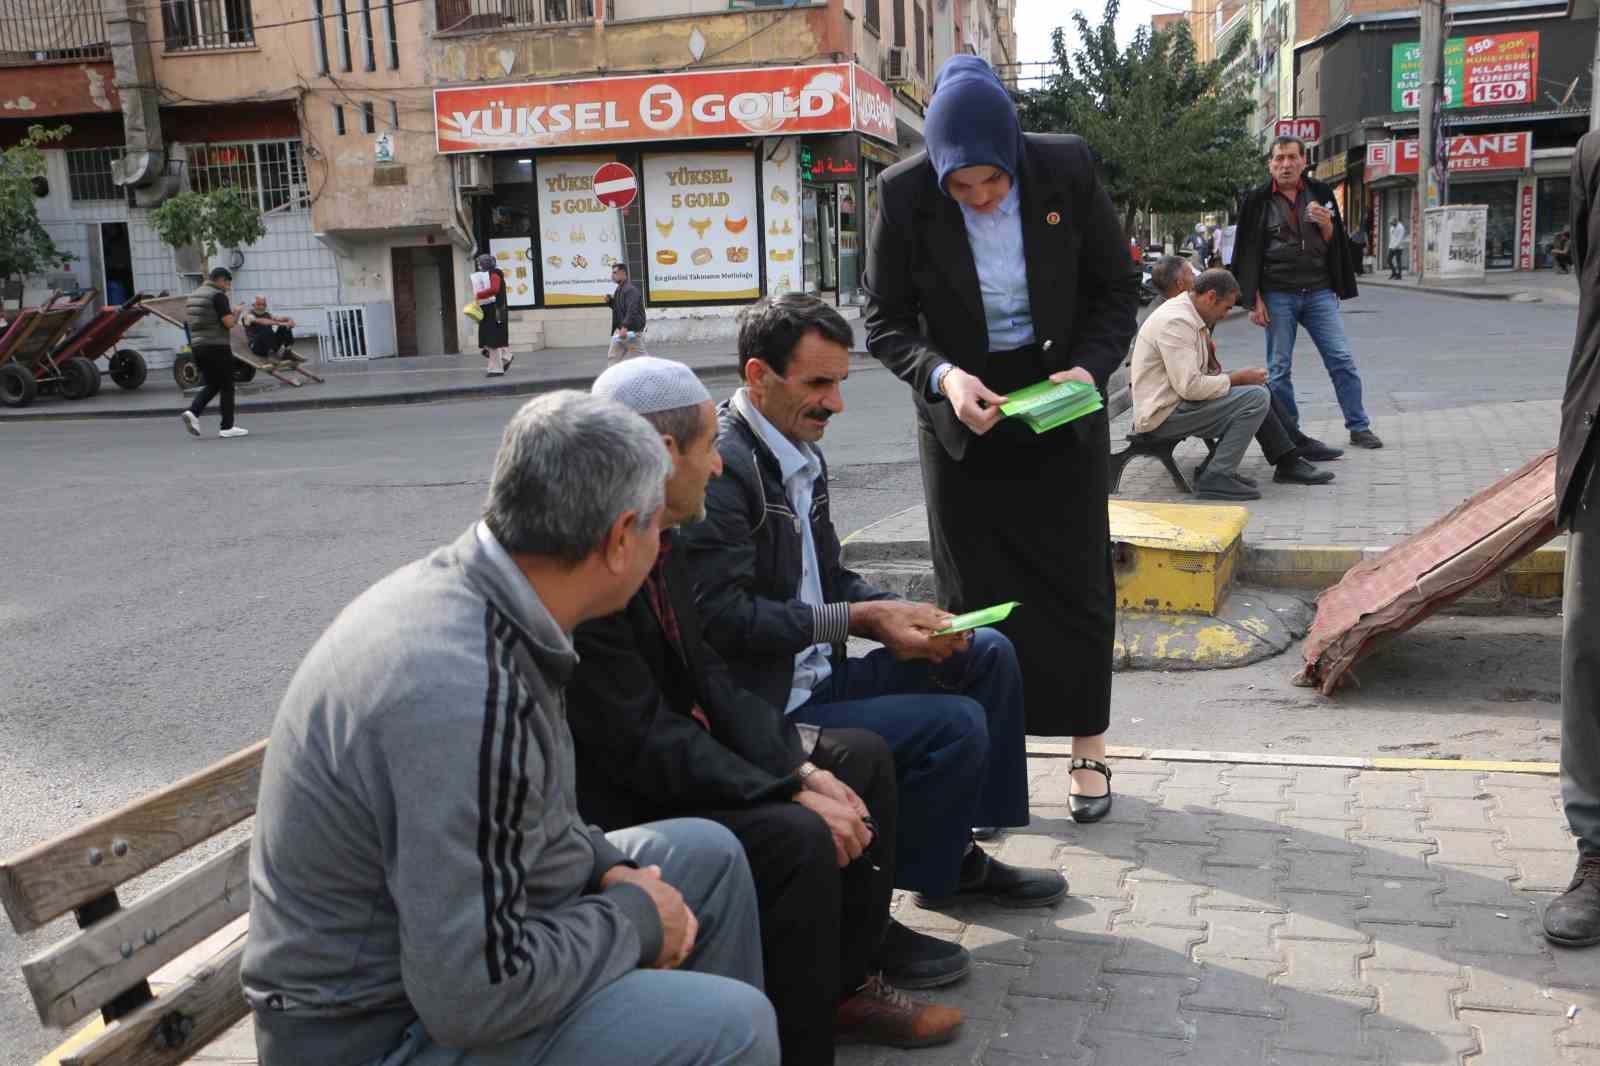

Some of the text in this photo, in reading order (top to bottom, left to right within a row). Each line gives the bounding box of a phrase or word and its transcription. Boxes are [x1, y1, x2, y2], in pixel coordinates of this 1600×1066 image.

[1472, 62, 1529, 74] KLASİK
[452, 101, 630, 138] YÜKSEL
[648, 91, 673, 118] 5
[692, 88, 834, 123] GOLD
[1279, 122, 1315, 139] BİM
[1404, 135, 1518, 159] EZANE
[545, 173, 593, 192] YÜKS
[666, 167, 733, 186] YÜKSEL
[550, 200, 561, 215] 5
[672, 191, 730, 208] 5 GOLD
[1520, 194, 1534, 268] ECZANE
